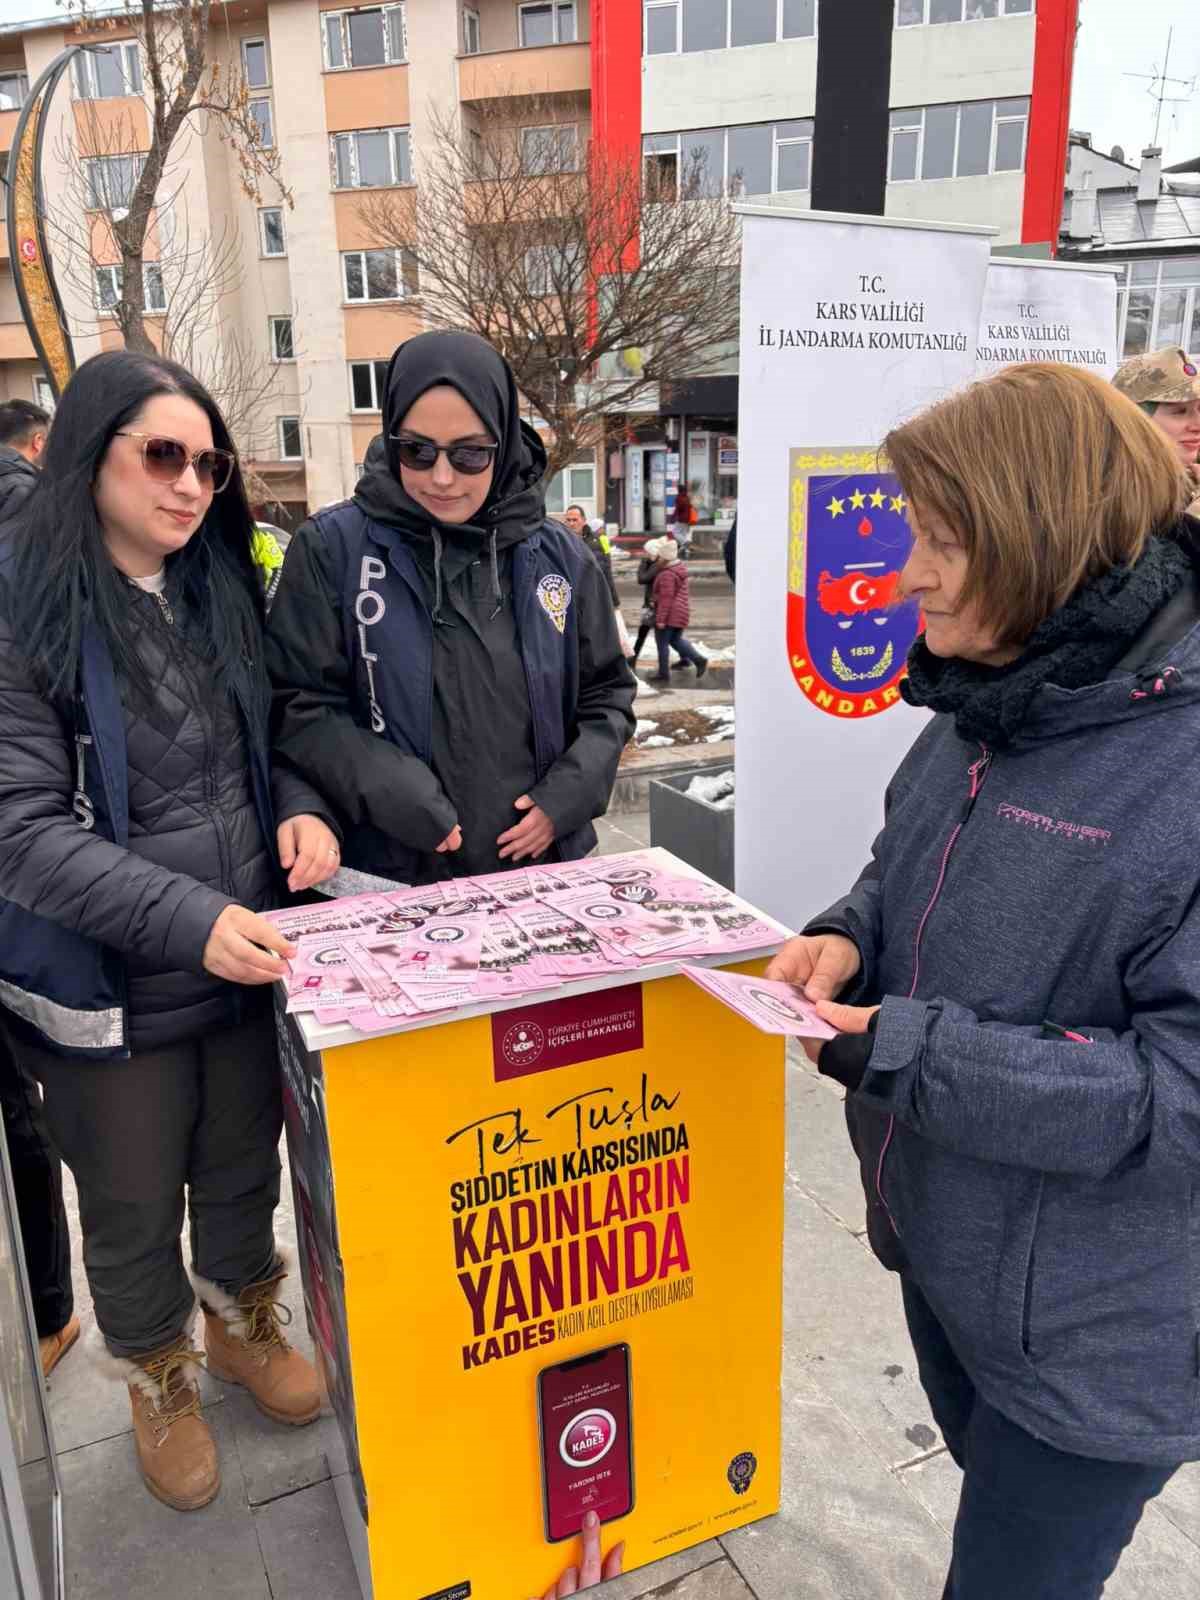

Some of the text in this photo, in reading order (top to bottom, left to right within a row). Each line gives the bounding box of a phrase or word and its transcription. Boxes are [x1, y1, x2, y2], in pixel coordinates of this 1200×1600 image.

[859, 275, 886, 294] T.C.
[816, 300, 925, 323] KARS VALİLİĞİ
[1017, 303, 1039, 319] T.C.
[759, 325, 968, 352] İL JANDARMA KOMUTANLIĞI
[987, 323, 1071, 342] KARS VALİLİĞİ
[587, 1019, 636, 1038] BAKANLIĞI
[446, 1072, 681, 1175] Tek Tuşla
[450, 1155, 558, 1213] ŞİDDETİN
[453, 1155, 691, 1269] KADINLARIN
[458, 1212, 690, 1337] YANINDA
[462, 1319, 556, 1370] KADES
[557, 1310, 585, 1340] KADIN
[608, 1291, 641, 1324] DESTEK
[642, 1276, 694, 1313] UYGULAMASI
[571, 1433, 605, 1453] KADES
